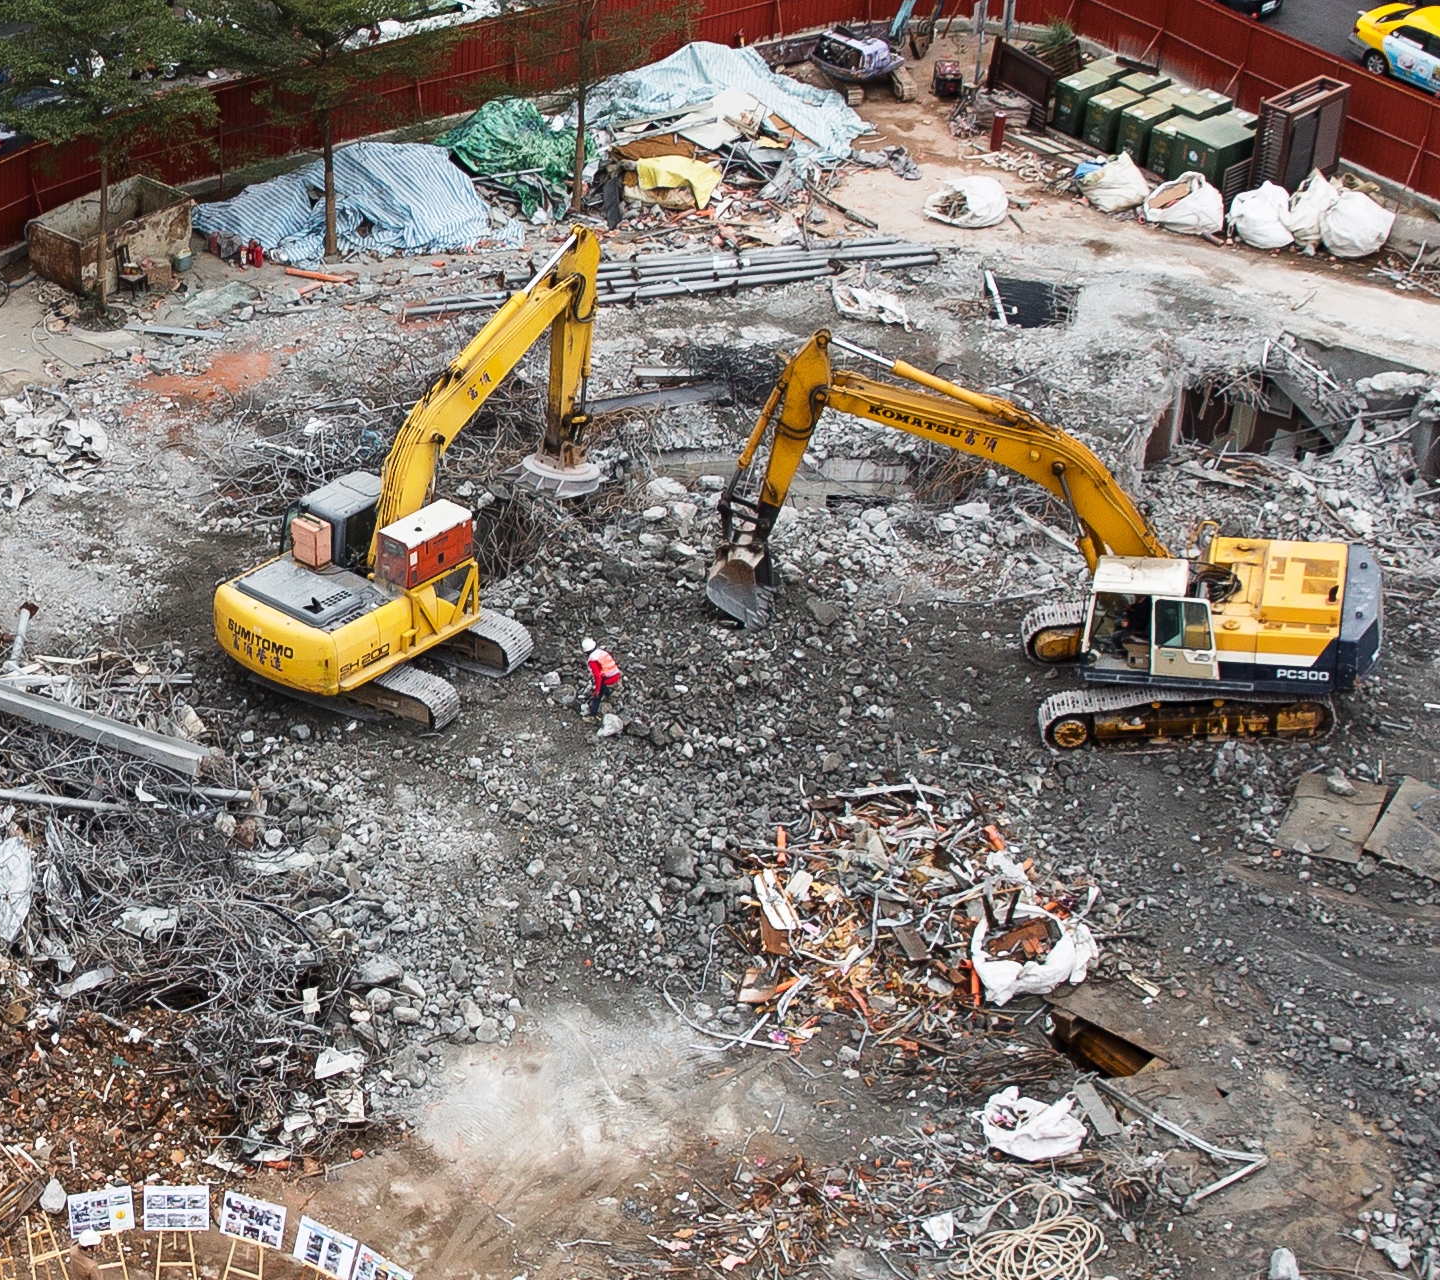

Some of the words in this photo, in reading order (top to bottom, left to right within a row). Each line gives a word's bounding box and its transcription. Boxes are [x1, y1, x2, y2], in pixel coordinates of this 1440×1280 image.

[868, 405, 963, 438] KOMATSU
[227, 617, 294, 660] SUMITOMO
[339, 657, 360, 676] SH
[361, 642, 390, 668] 200
[1276, 668, 1330, 681] PC300
